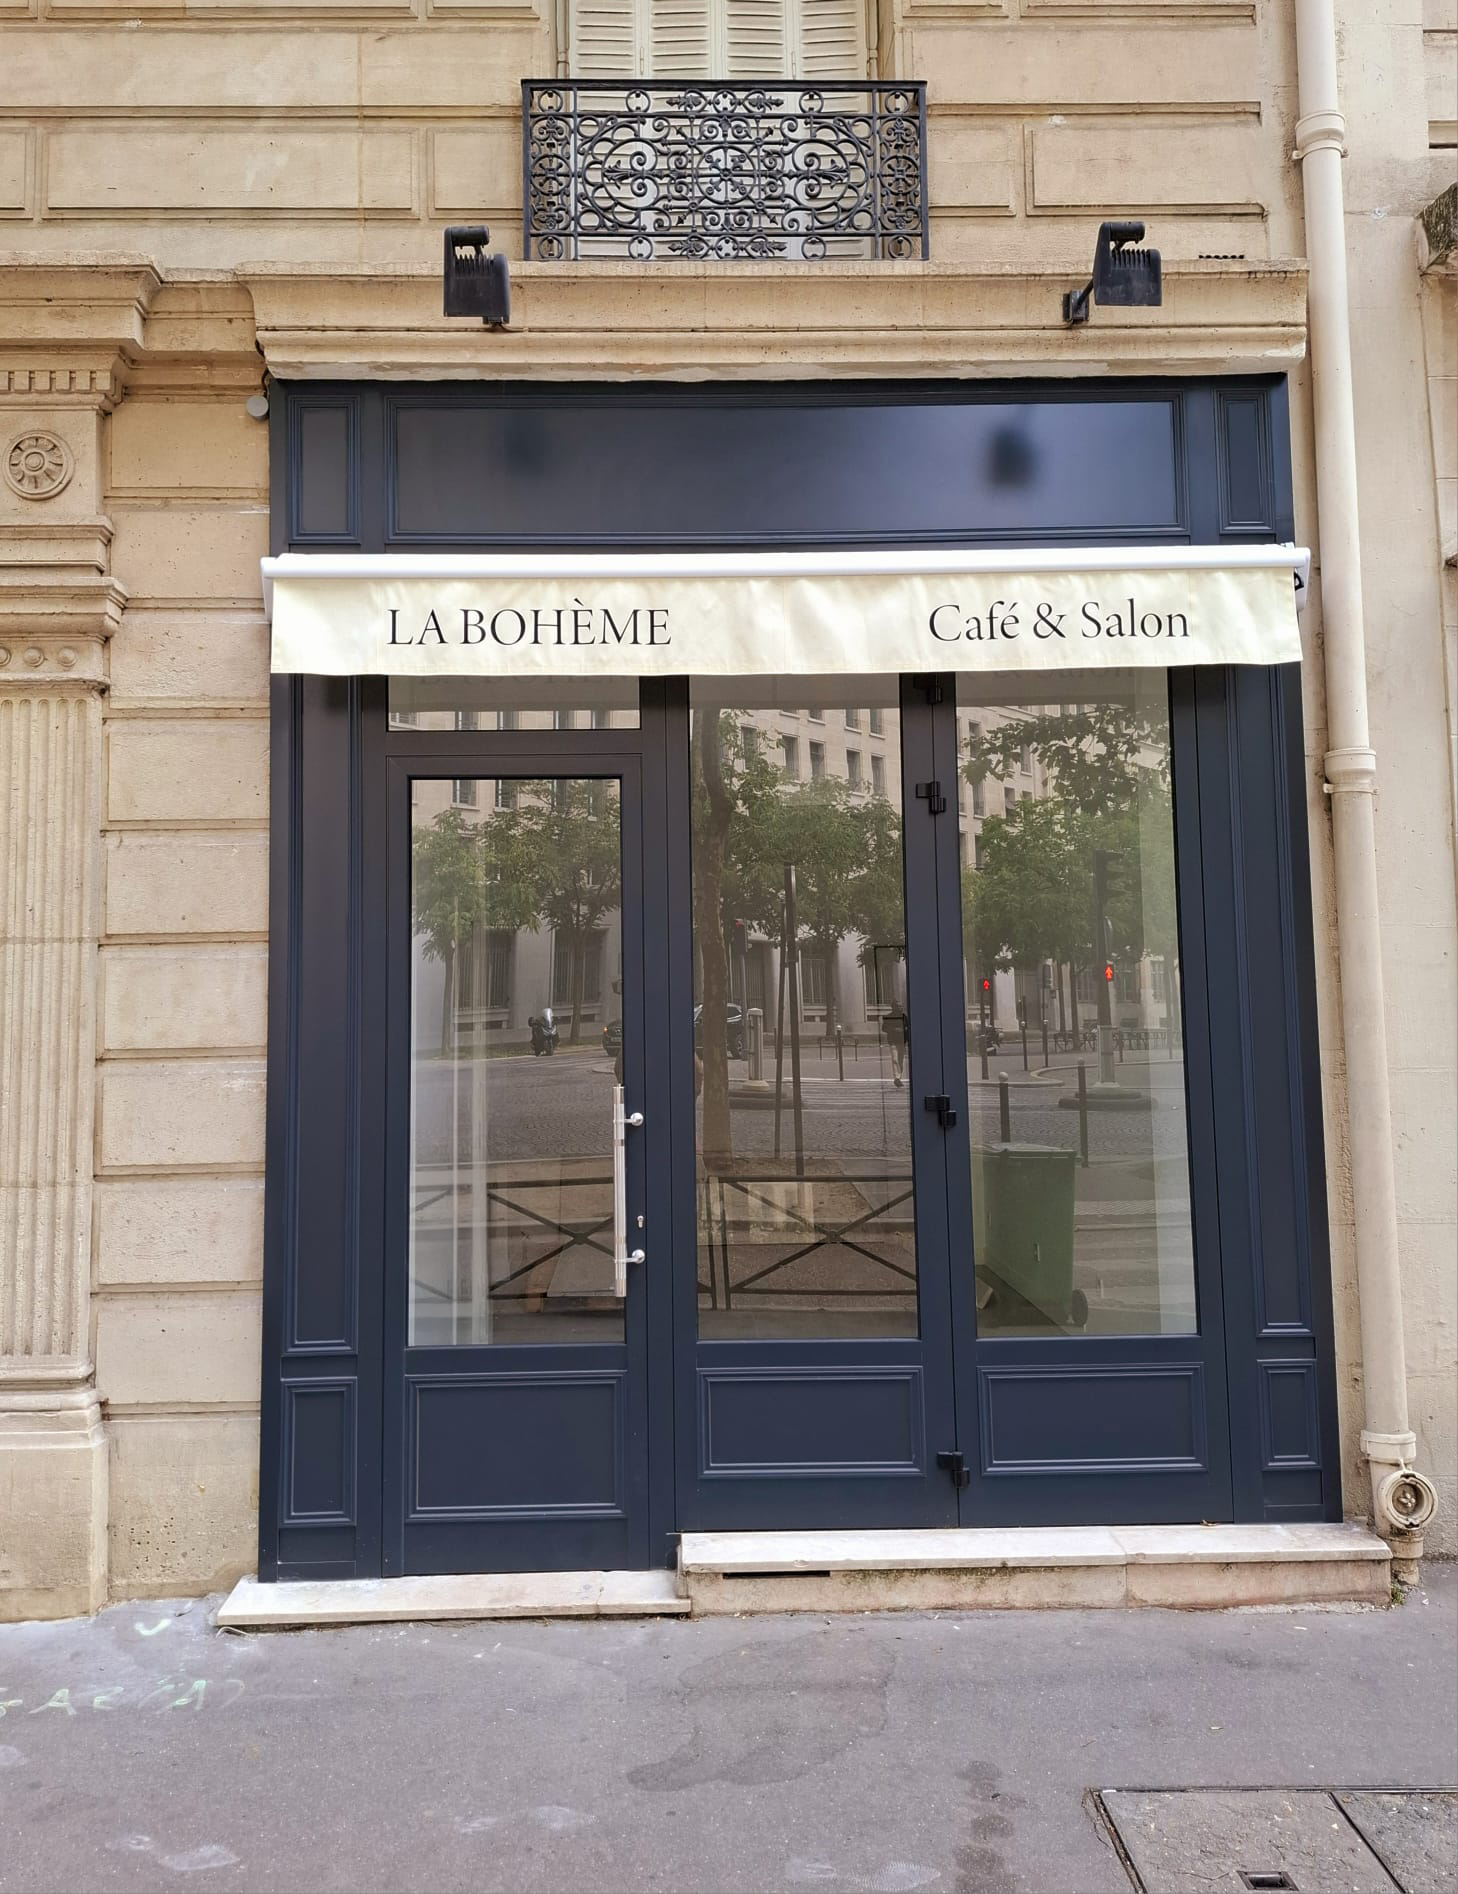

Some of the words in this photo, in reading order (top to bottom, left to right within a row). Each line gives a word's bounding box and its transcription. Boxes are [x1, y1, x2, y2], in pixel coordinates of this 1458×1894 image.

[387, 608, 448, 645] LA
[460, 597, 672, 646] BOHÈME
[929, 600, 1020, 642] Café
[1033, 603, 1067, 639] &
[1082, 598, 1191, 638] Salon
